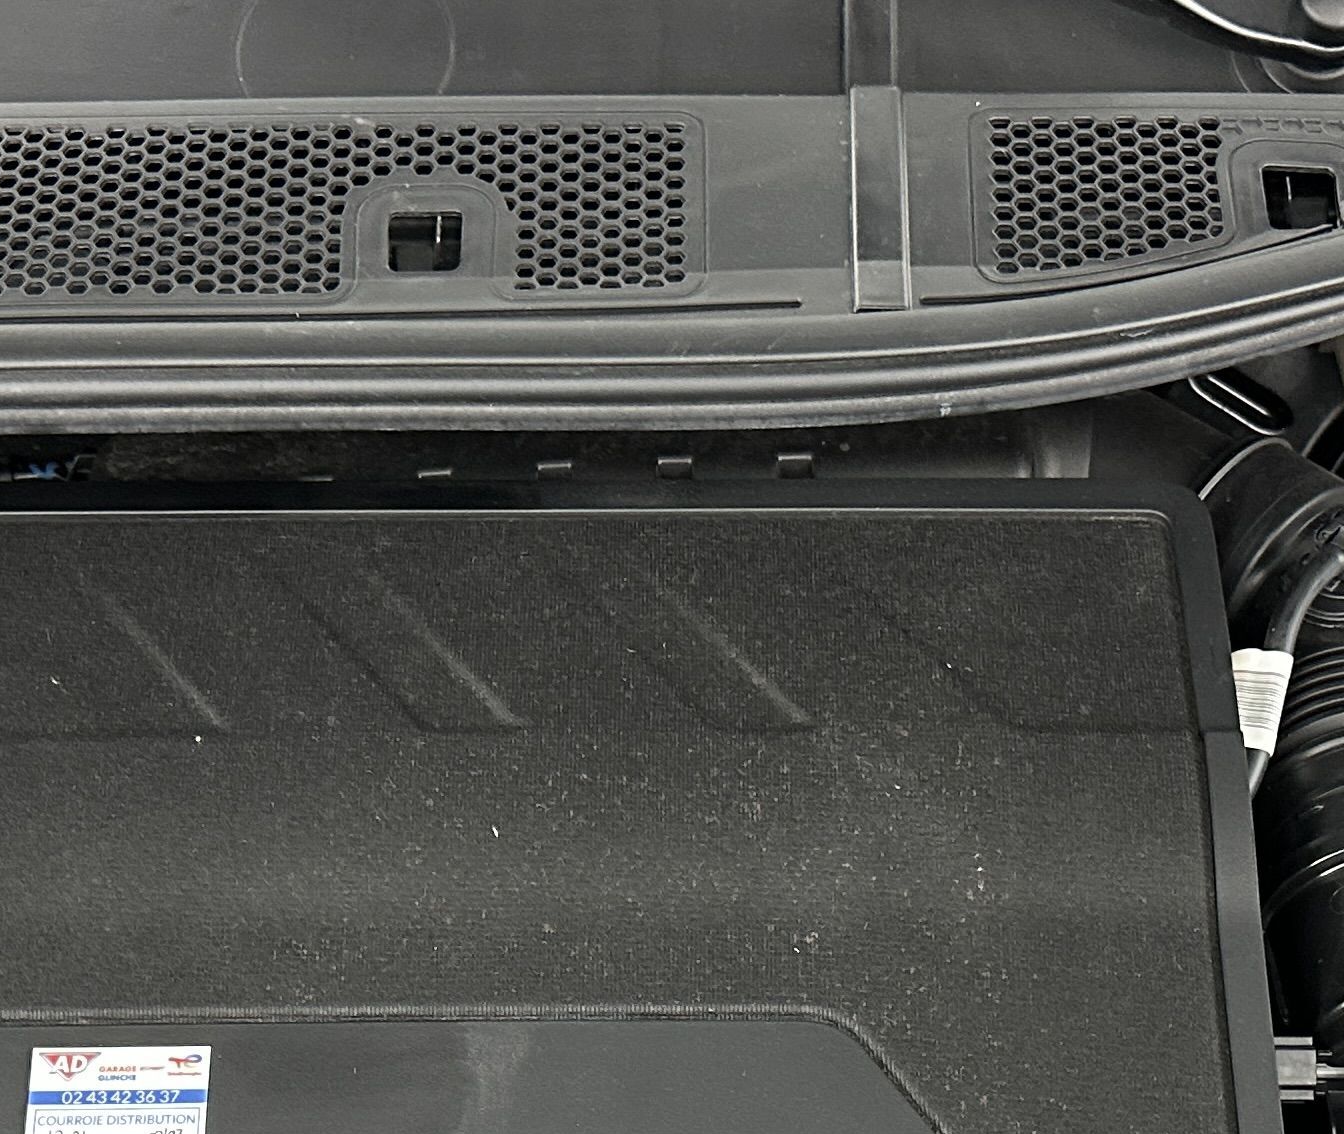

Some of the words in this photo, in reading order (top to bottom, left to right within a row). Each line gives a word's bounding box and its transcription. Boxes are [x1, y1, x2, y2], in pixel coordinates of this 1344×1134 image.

[55, 1055, 88, 1073] AD
[61, 1092, 82, 1104] 02
[86, 1092, 106, 1104] 43
[109, 1091, 132, 1103] 42
[135, 1091, 156, 1103] 36
[159, 1089, 181, 1103] 37
[37, 1114, 103, 1126] COURROIE
[107, 1113, 195, 1125] DISTRIBUTION
